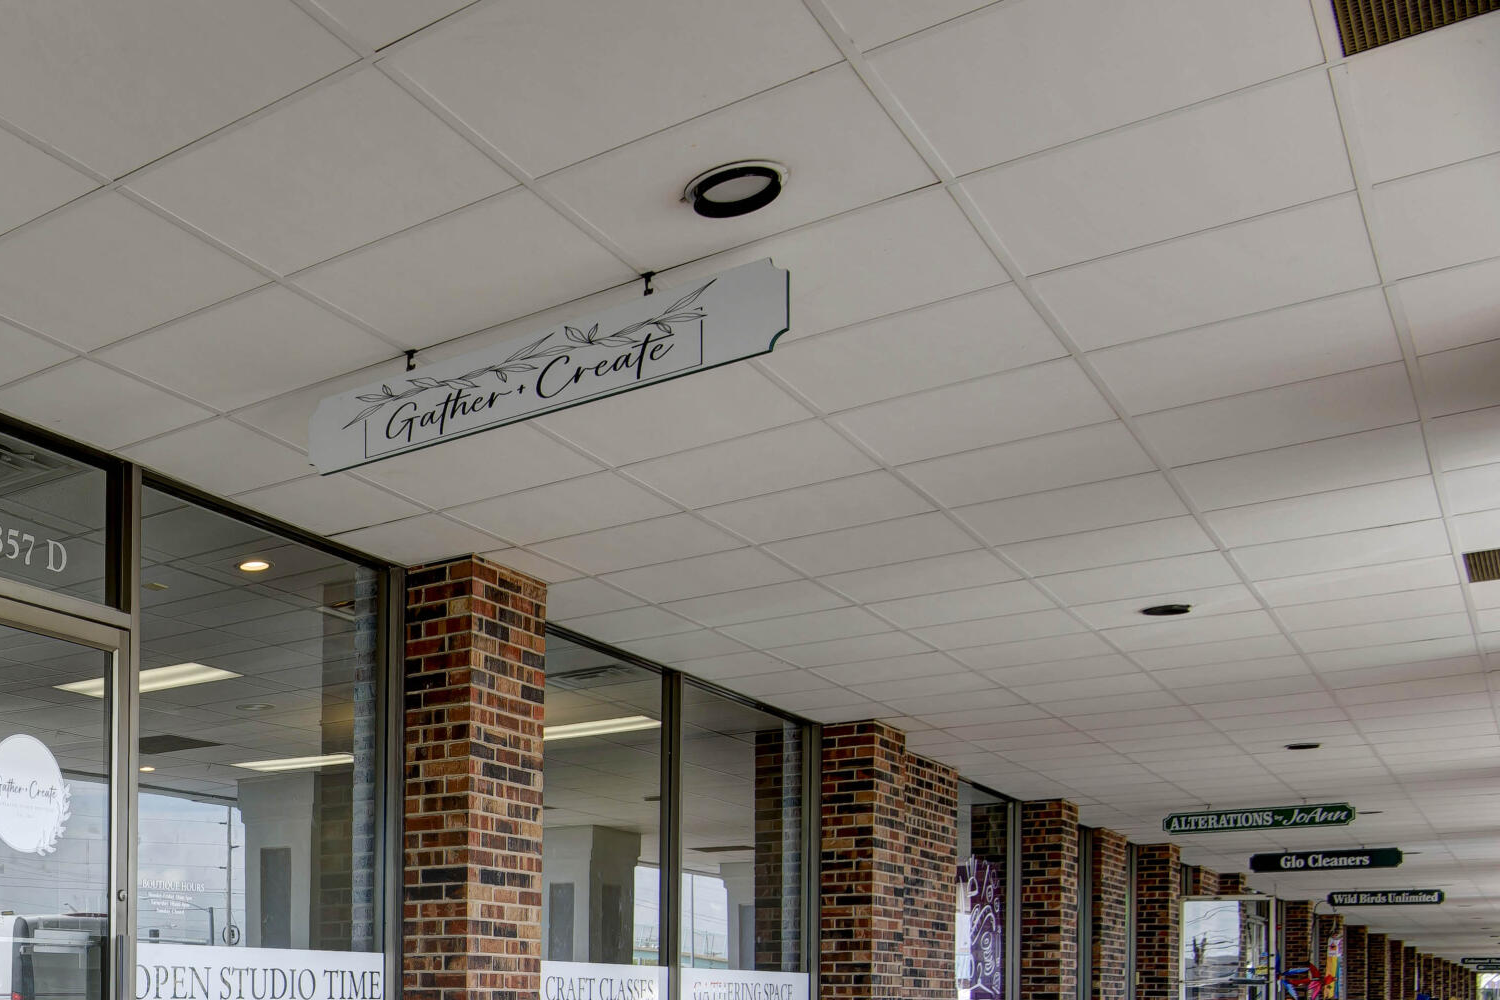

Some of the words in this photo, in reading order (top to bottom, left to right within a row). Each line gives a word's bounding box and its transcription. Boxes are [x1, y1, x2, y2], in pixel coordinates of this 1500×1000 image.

[385, 386, 512, 443] Gather
[535, 332, 675, 400] Create
[47, 538, 67, 573] D
[29, 780, 58, 805] Create
[1170, 811, 1273, 831] ALTERATIONS
[1283, 807, 1348, 826] JoAnn
[1280, 855, 1304, 869] Glo
[1308, 854, 1370, 868] Cleaners
[142, 879, 179, 891] BOUTIQUE
[182, 881, 205, 892] HOURS
[1333, 893, 1358, 904] Wild
[1359, 893, 1387, 904] Birds
[1388, 892, 1438, 903] Unlimited
[135, 964, 211, 1000] OPEN
[219, 966, 316, 1000] STUDIO
[323, 969, 381, 1000] TIME
